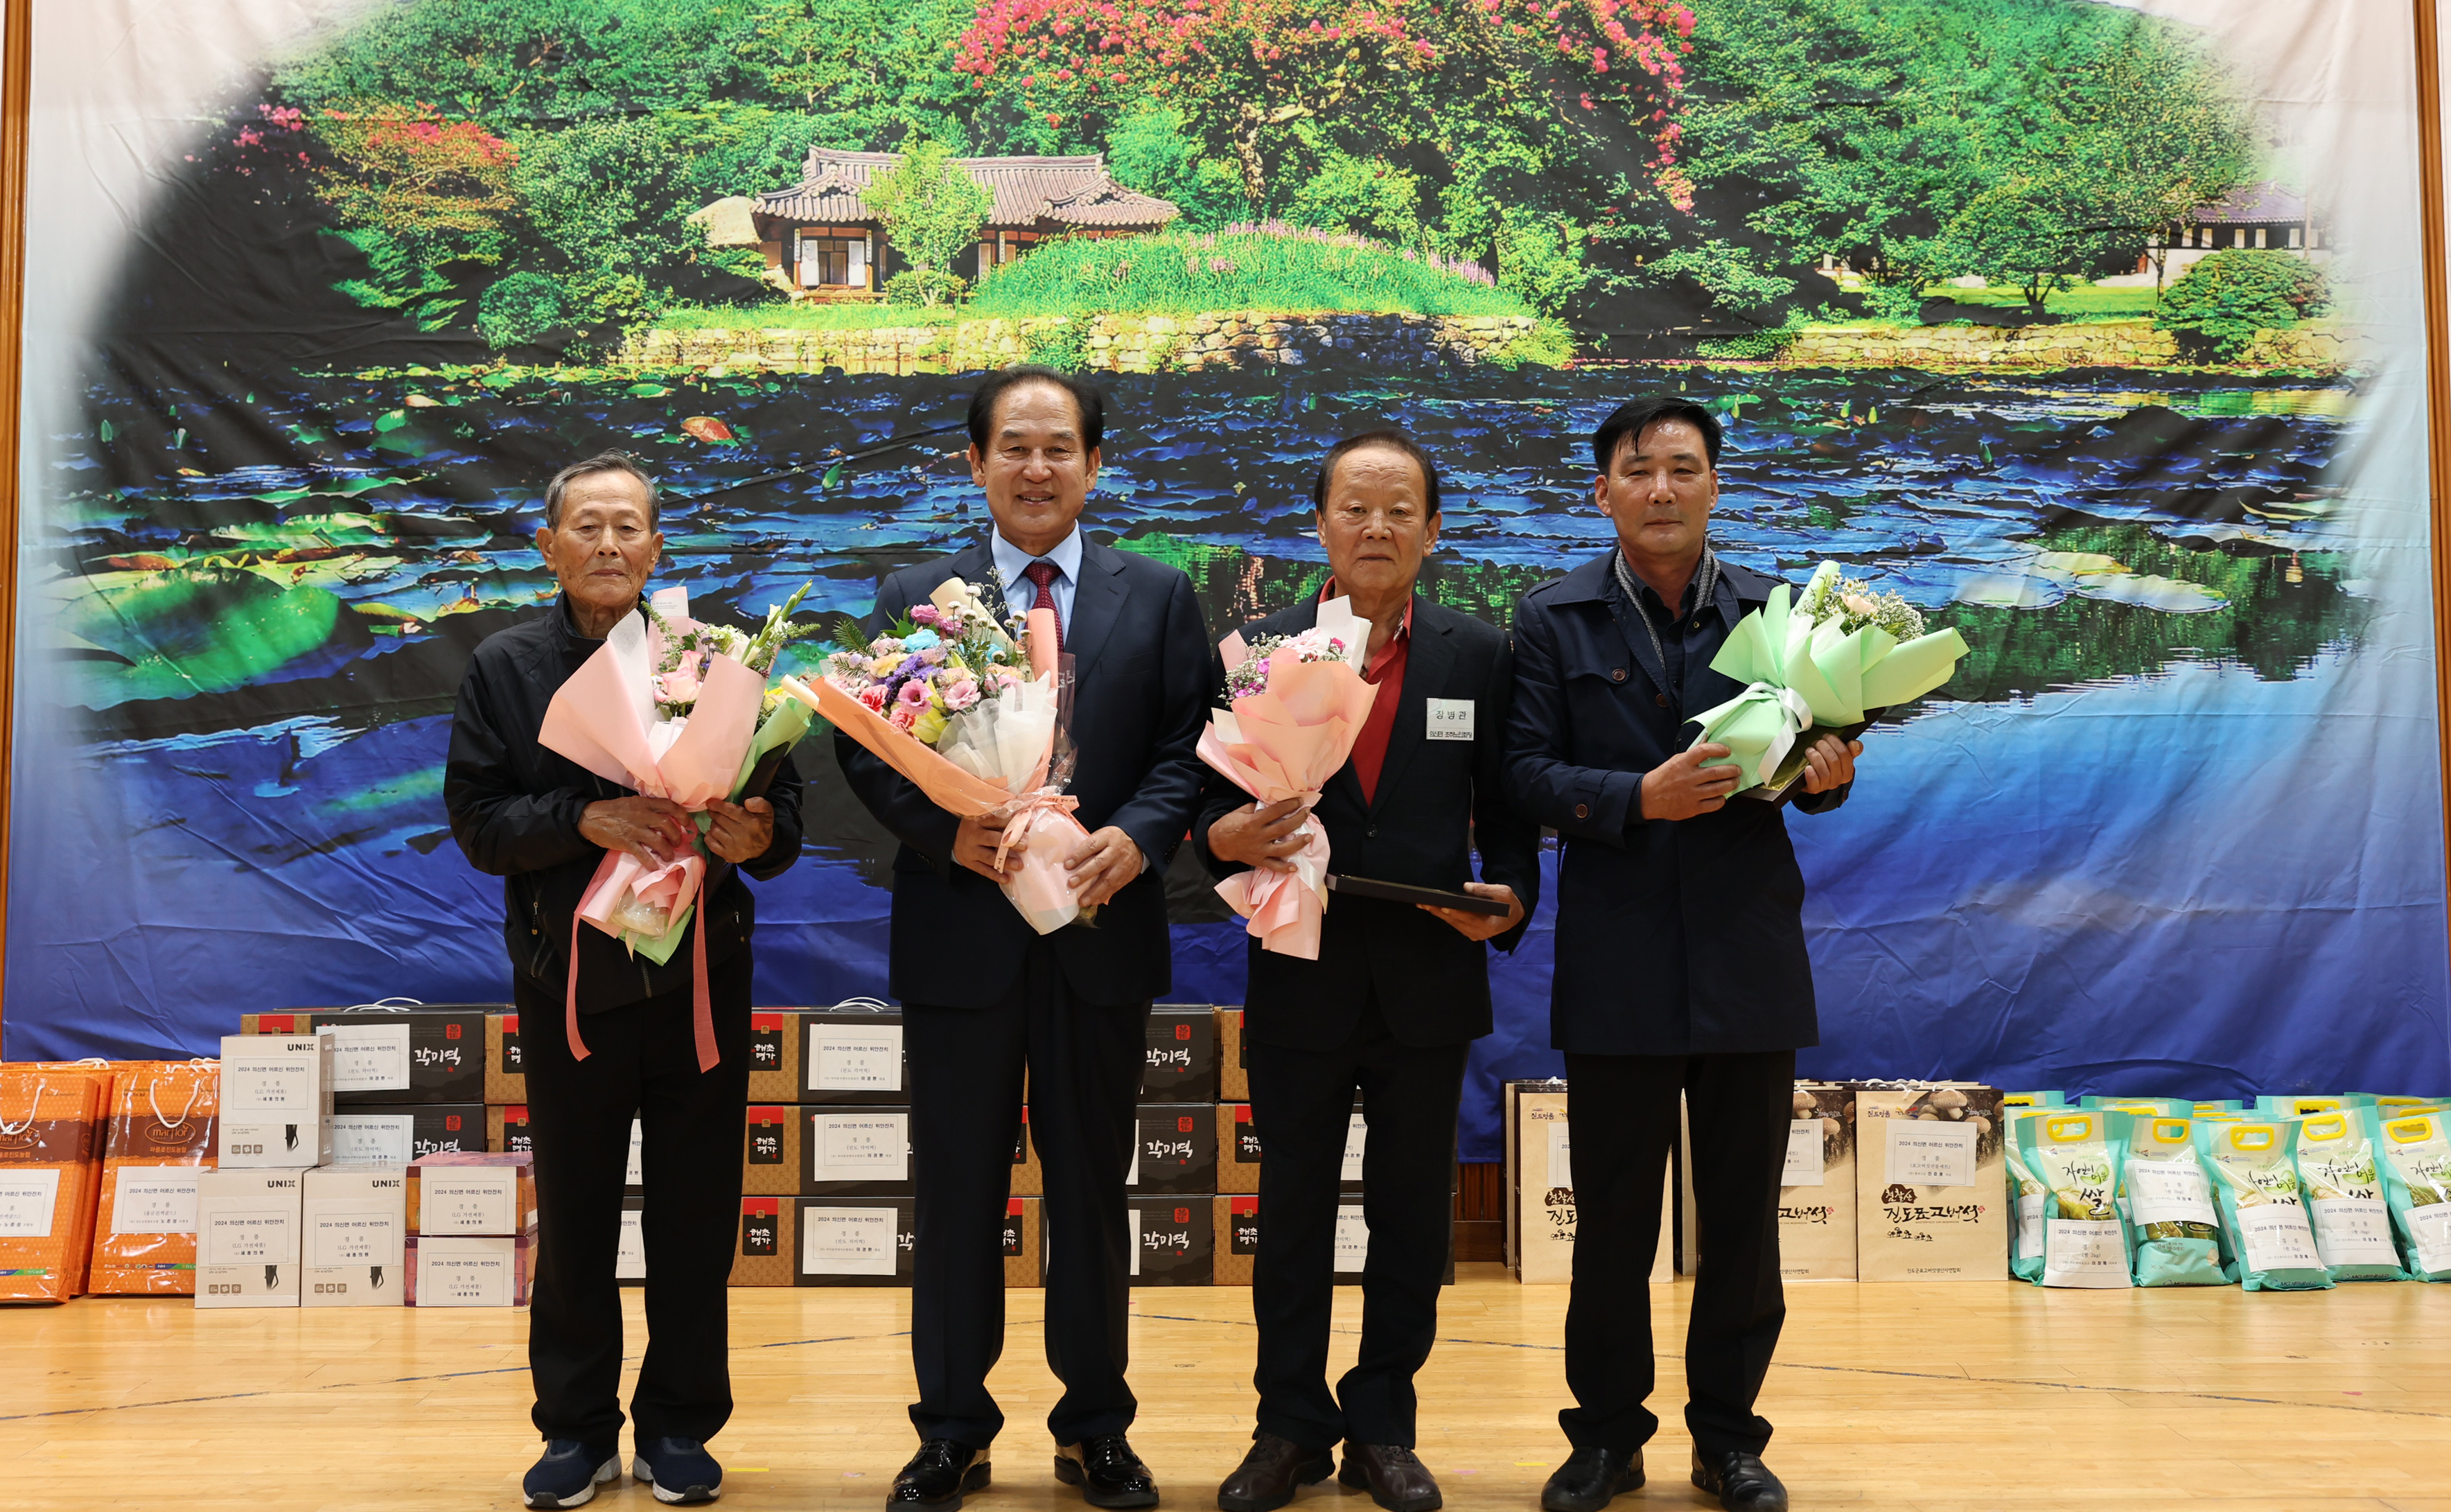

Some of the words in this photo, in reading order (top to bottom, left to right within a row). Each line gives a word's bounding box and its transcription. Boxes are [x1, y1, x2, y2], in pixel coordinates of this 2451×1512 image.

[755, 1044, 775, 1052] 해초
[414, 1047, 462, 1066] 각미역
[755, 1053, 775, 1061] 명가
[755, 1137, 776, 1145] 해초
[757, 1146, 777, 1154] 명가
[1147, 1140, 1193, 1158] 각미역
[2080, 1188, 2109, 1215] 쌀
[1883, 1204, 1978, 1223] 진도표고버섯
[750, 1228, 770, 1236] 해초
[1238, 1227, 1258, 1236] 해초
[751, 1238, 771, 1246] 명가
[1143, 1231, 1189, 1249] 각미역
[1240, 1236, 1258, 1245] 명가
